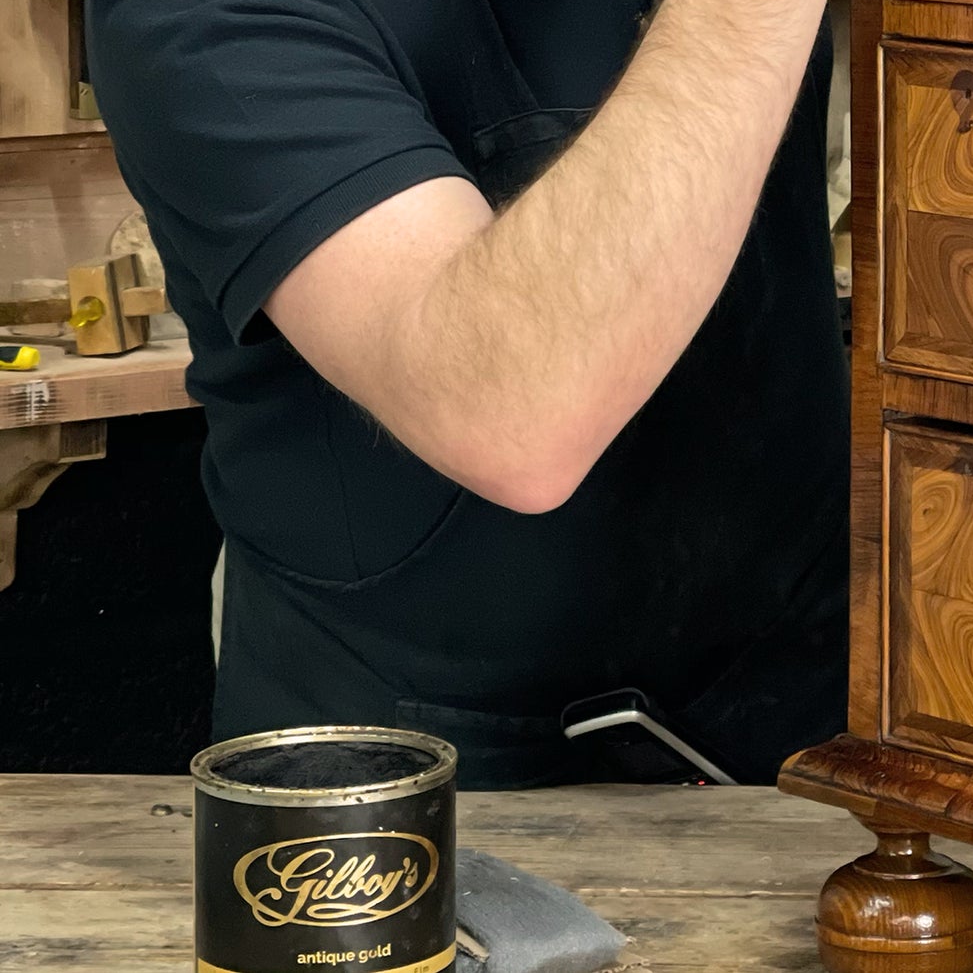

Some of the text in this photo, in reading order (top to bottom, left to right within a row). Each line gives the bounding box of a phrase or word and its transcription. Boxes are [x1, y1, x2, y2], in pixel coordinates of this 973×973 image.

[254, 848, 419, 925] Gilboy's
[297, 943, 392, 967] antique gold
